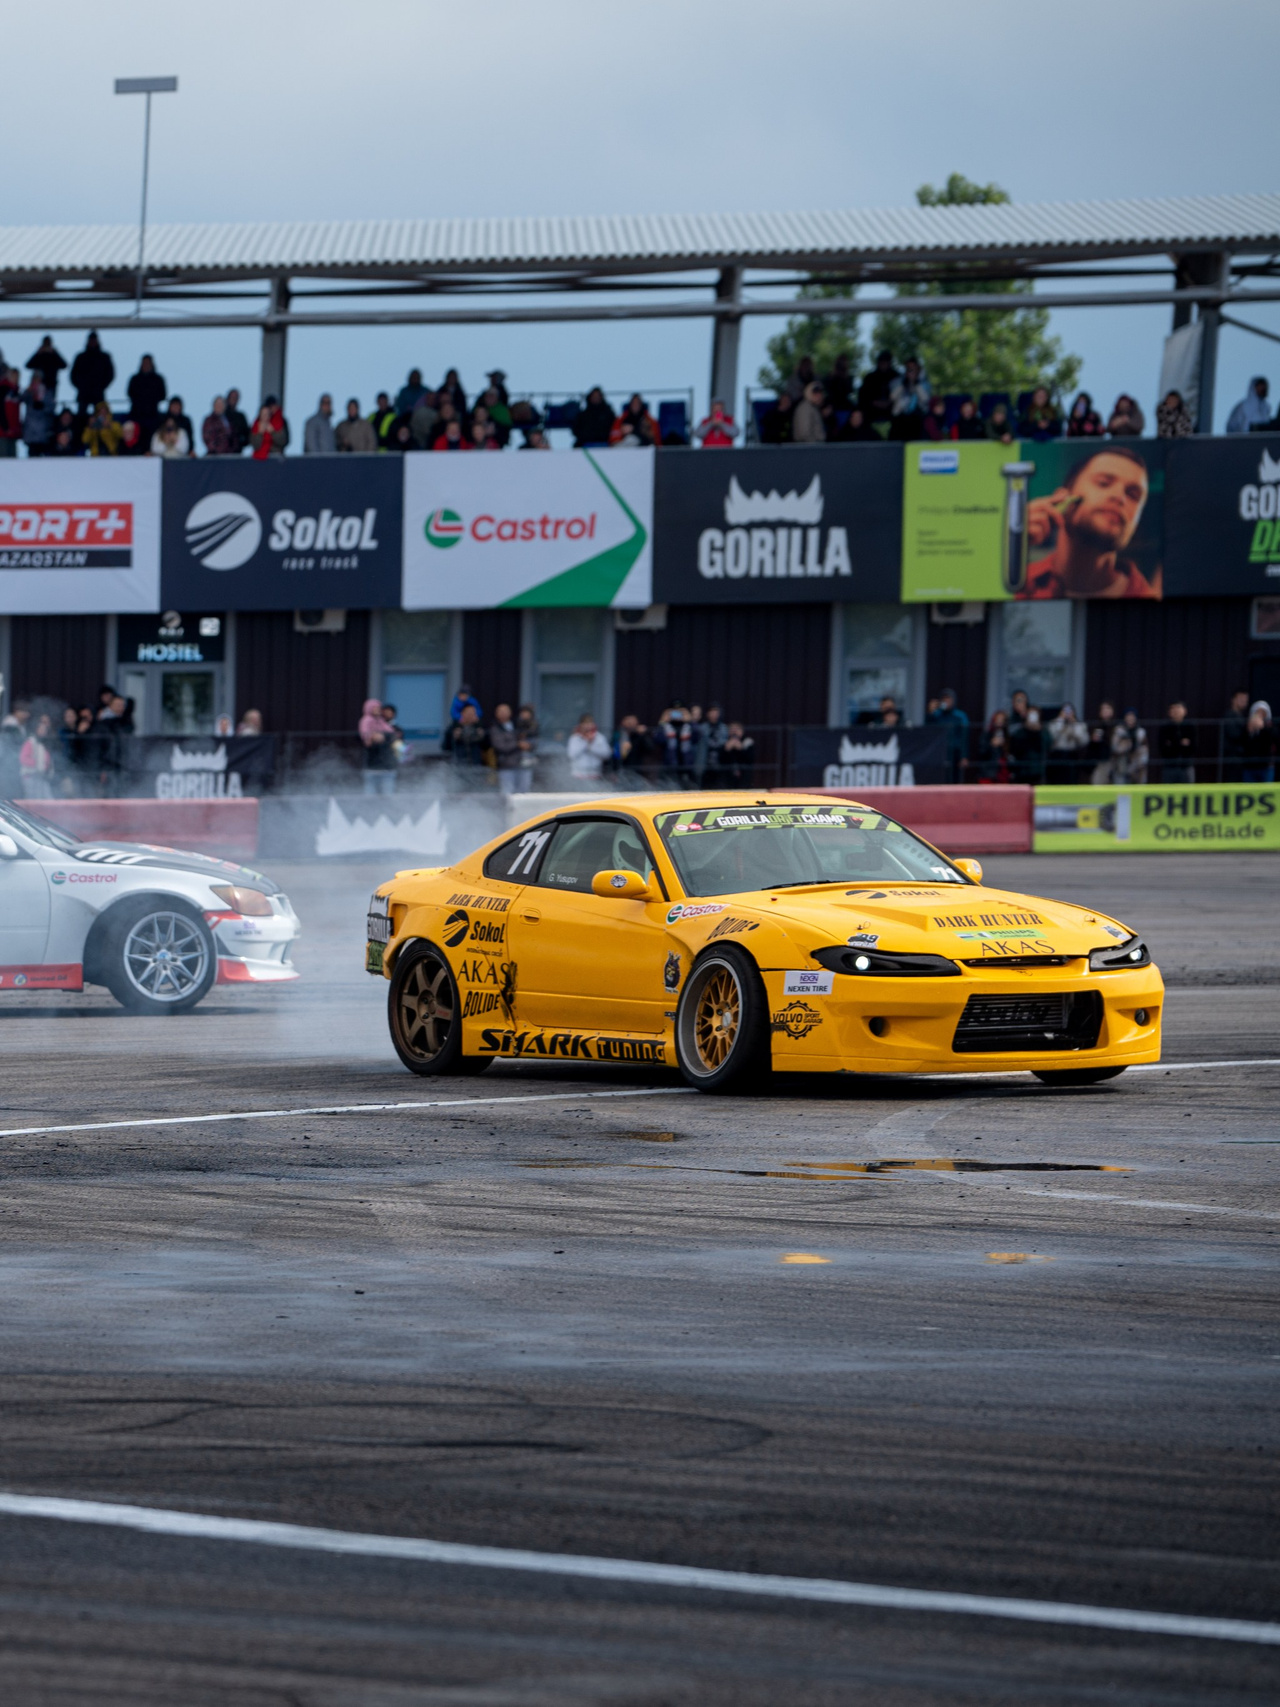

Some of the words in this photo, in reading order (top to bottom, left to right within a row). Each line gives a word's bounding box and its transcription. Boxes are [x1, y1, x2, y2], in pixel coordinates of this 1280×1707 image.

[471, 512, 597, 543] Castrol
[697, 526, 853, 579] GORILLA
[137, 643, 204, 662] HOSTEL
[156, 771, 243, 798] GORILLA
[1143, 792, 1276, 818] PHILIPS
[1153, 822, 1265, 841] OneBlade
[507, 831, 551, 875] 71
[69, 873, 117, 883] Castrol
[930, 867, 964, 883] 71
[933, 915, 978, 928] DARK
[979, 913, 1043, 926] HUNTER
[982, 940, 1056, 956] AKAS
[457, 960, 511, 985] AKAS
[461, 990, 500, 1019] BOLIDE
[773, 1013, 803, 1023] VOLVO
[479, 1028, 598, 1058] SHARK
